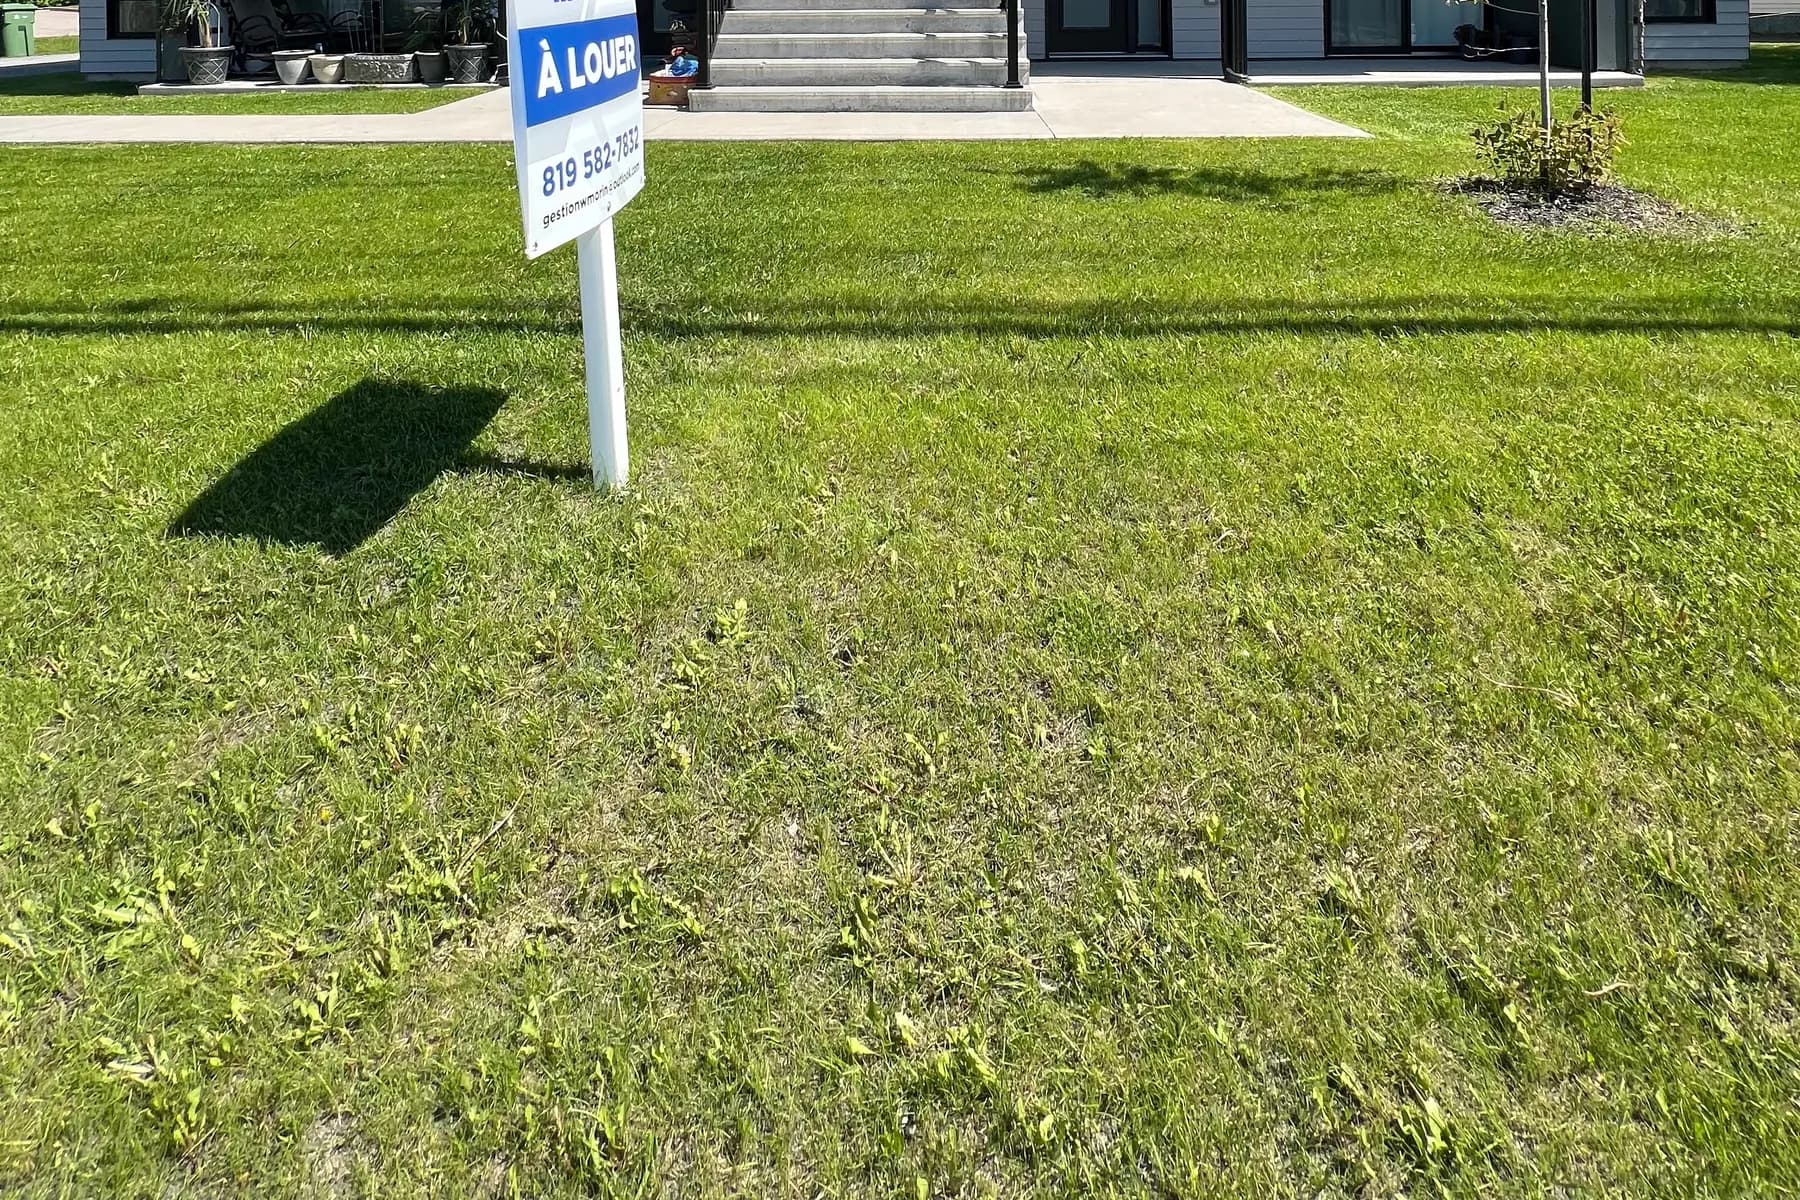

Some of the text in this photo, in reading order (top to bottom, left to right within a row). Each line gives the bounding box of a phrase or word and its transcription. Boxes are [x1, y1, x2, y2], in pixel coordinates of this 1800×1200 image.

[537, 34, 637, 99] À LOUER
[543, 125, 639, 197] 819 582-7832
